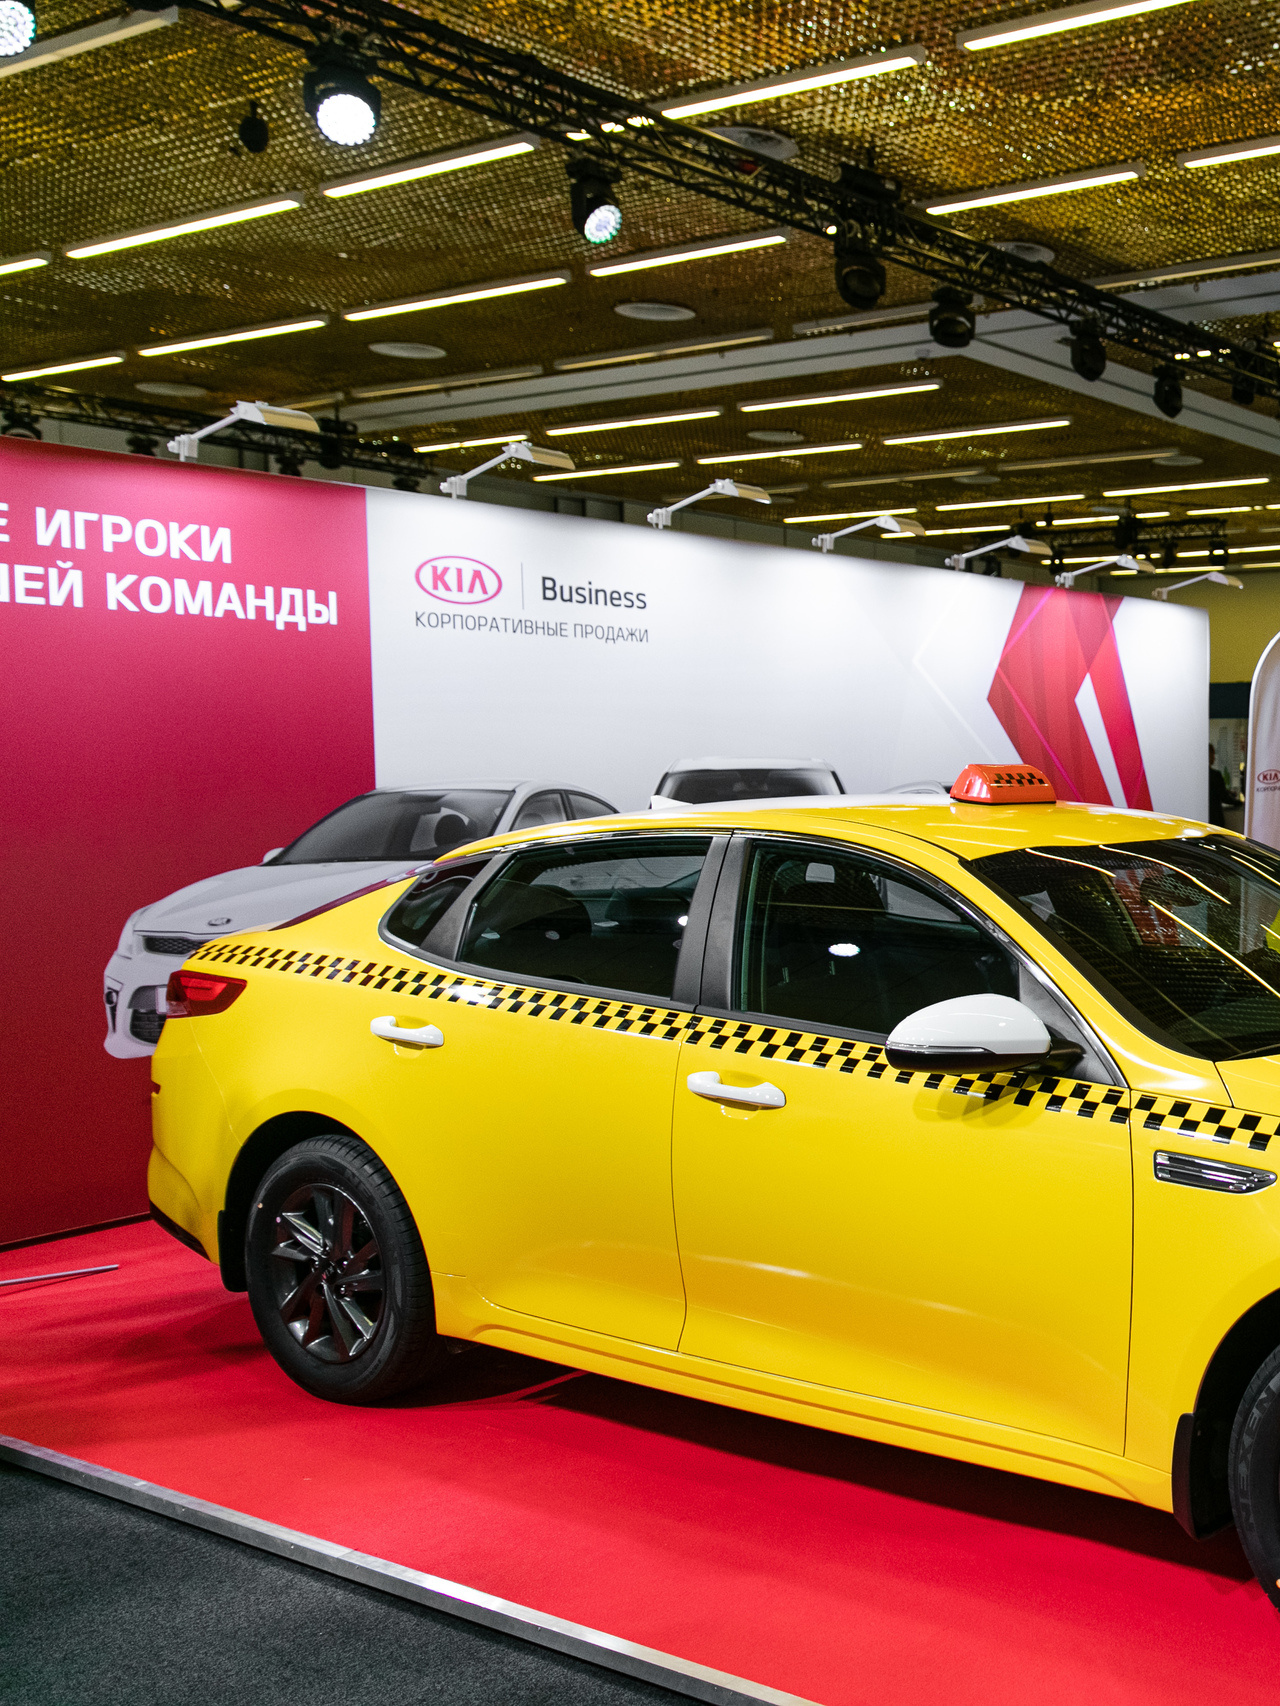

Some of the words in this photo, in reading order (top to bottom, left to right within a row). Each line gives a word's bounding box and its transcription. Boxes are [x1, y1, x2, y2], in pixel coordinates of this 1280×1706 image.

[35, 506, 232, 564] ИГРОКИ
[106, 572, 338, 632] КОМАНДЫ
[430, 565, 489, 596] KIA
[541, 576, 648, 610] Business
[415, 611, 569, 638] КОРПОРАТИВНЫЕ
[574, 623, 649, 645] ПРОДАЖИ
[1262, 772, 1279, 781] KIA
